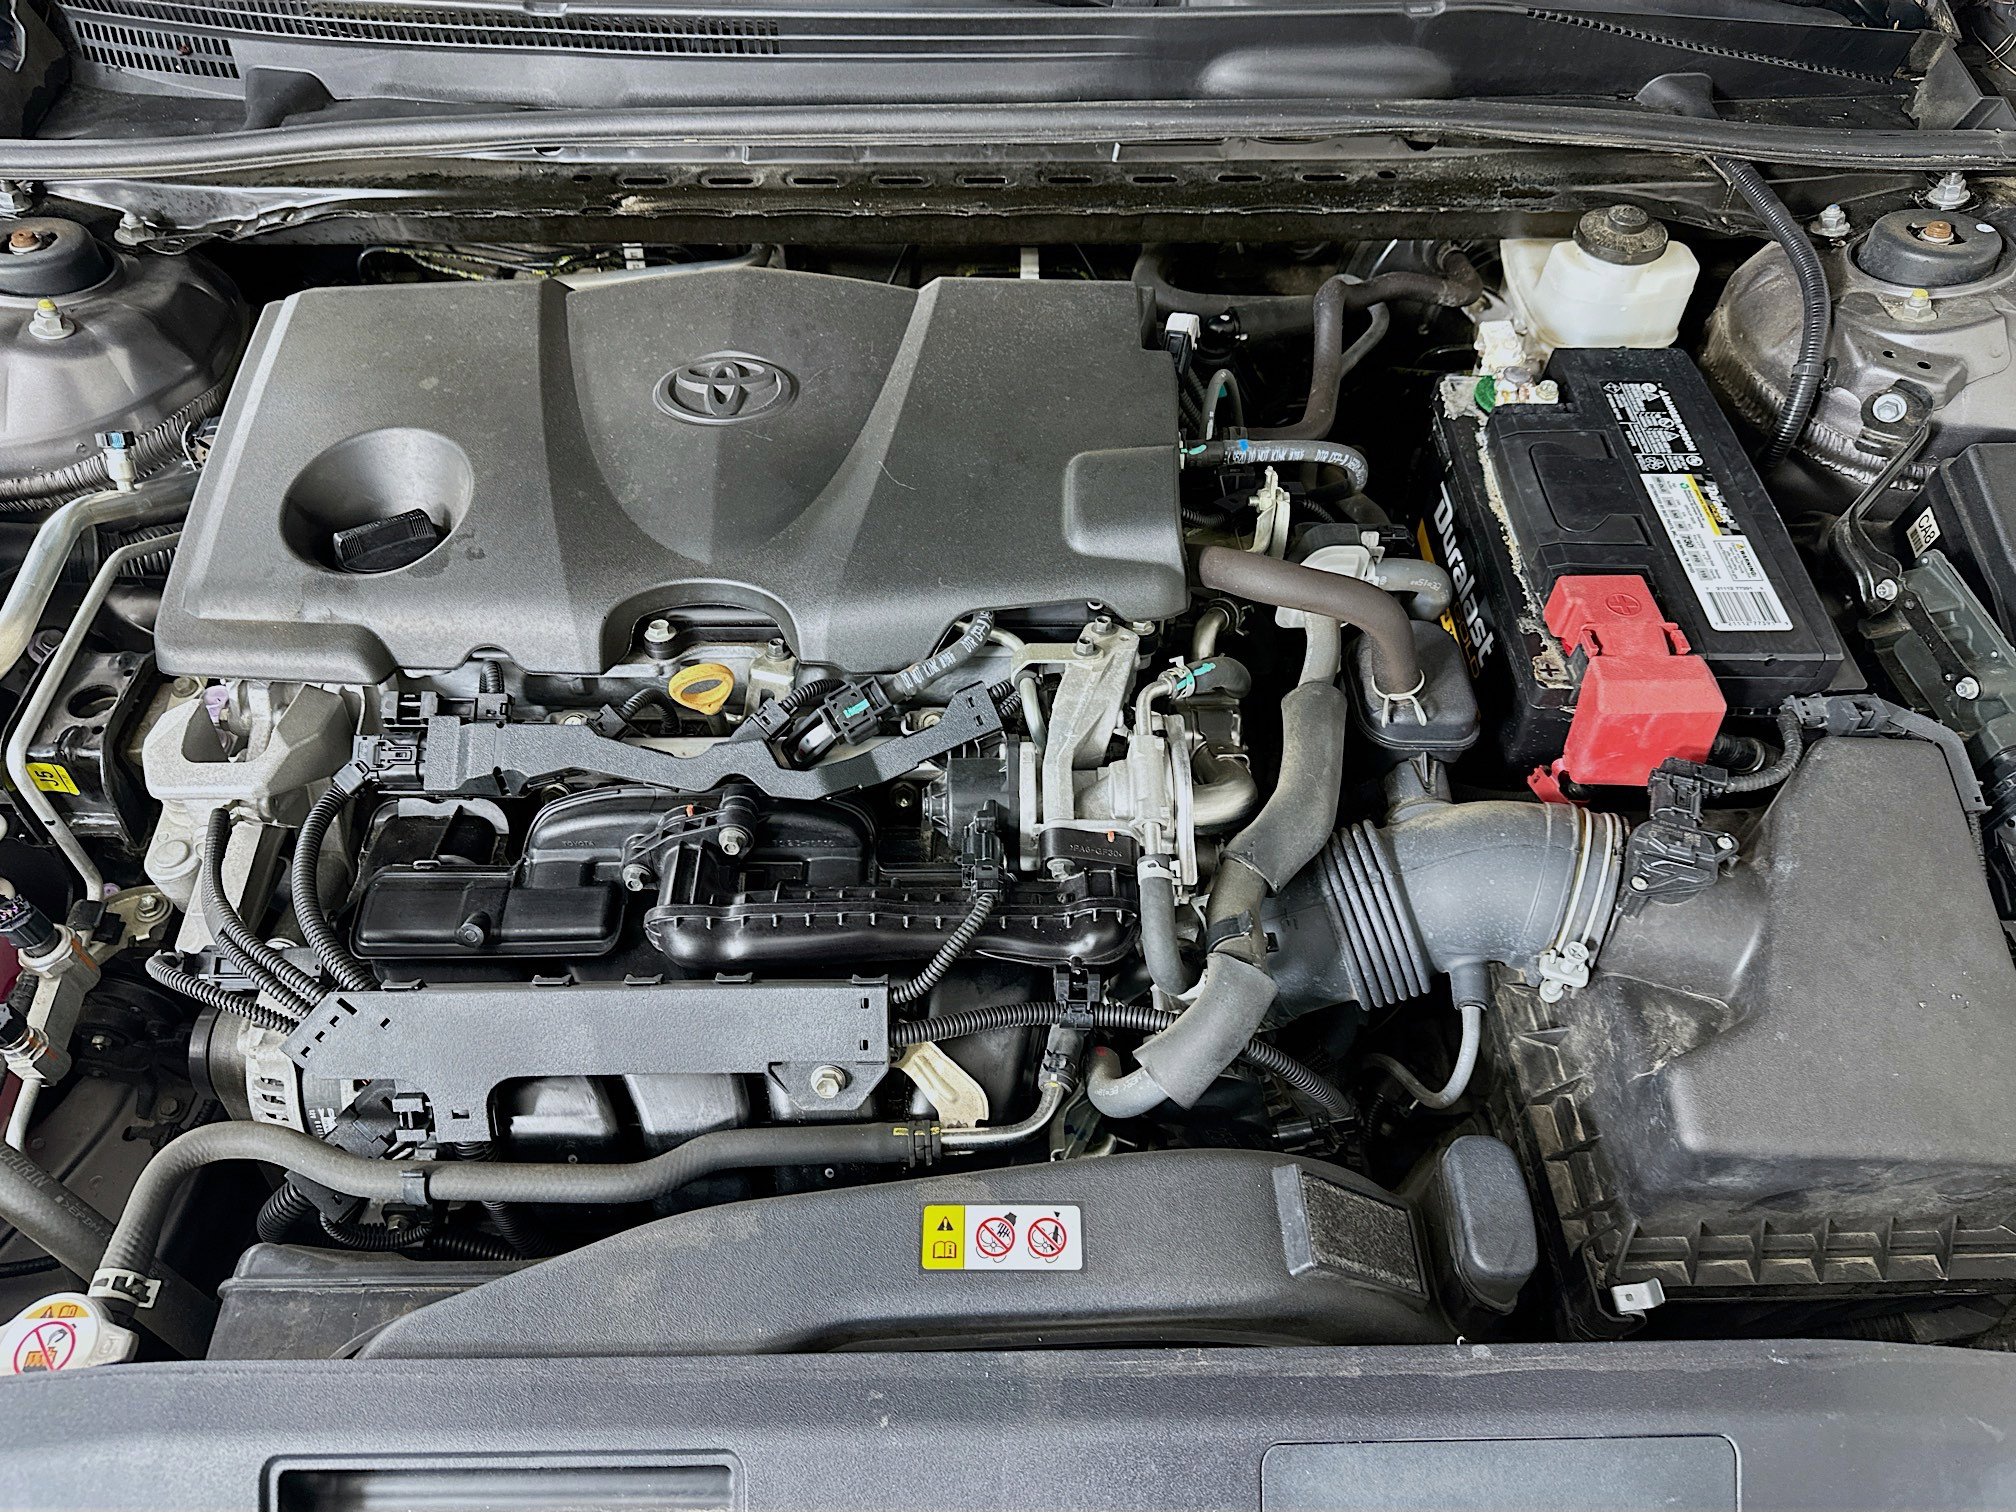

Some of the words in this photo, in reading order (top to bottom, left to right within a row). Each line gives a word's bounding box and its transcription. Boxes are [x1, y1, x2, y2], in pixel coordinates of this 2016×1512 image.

[1704, 484, 1736, 524] Duralast
[1682, 535, 1694, 548] 730
[1918, 513, 1935, 544] CA8
[1434, 481, 1494, 669] Duralast
[1454, 601, 1480, 678] GOLD
[910, 666, 924, 684] NOT
[922, 659, 940, 678] KINK
[34, 770, 59, 786] J5
